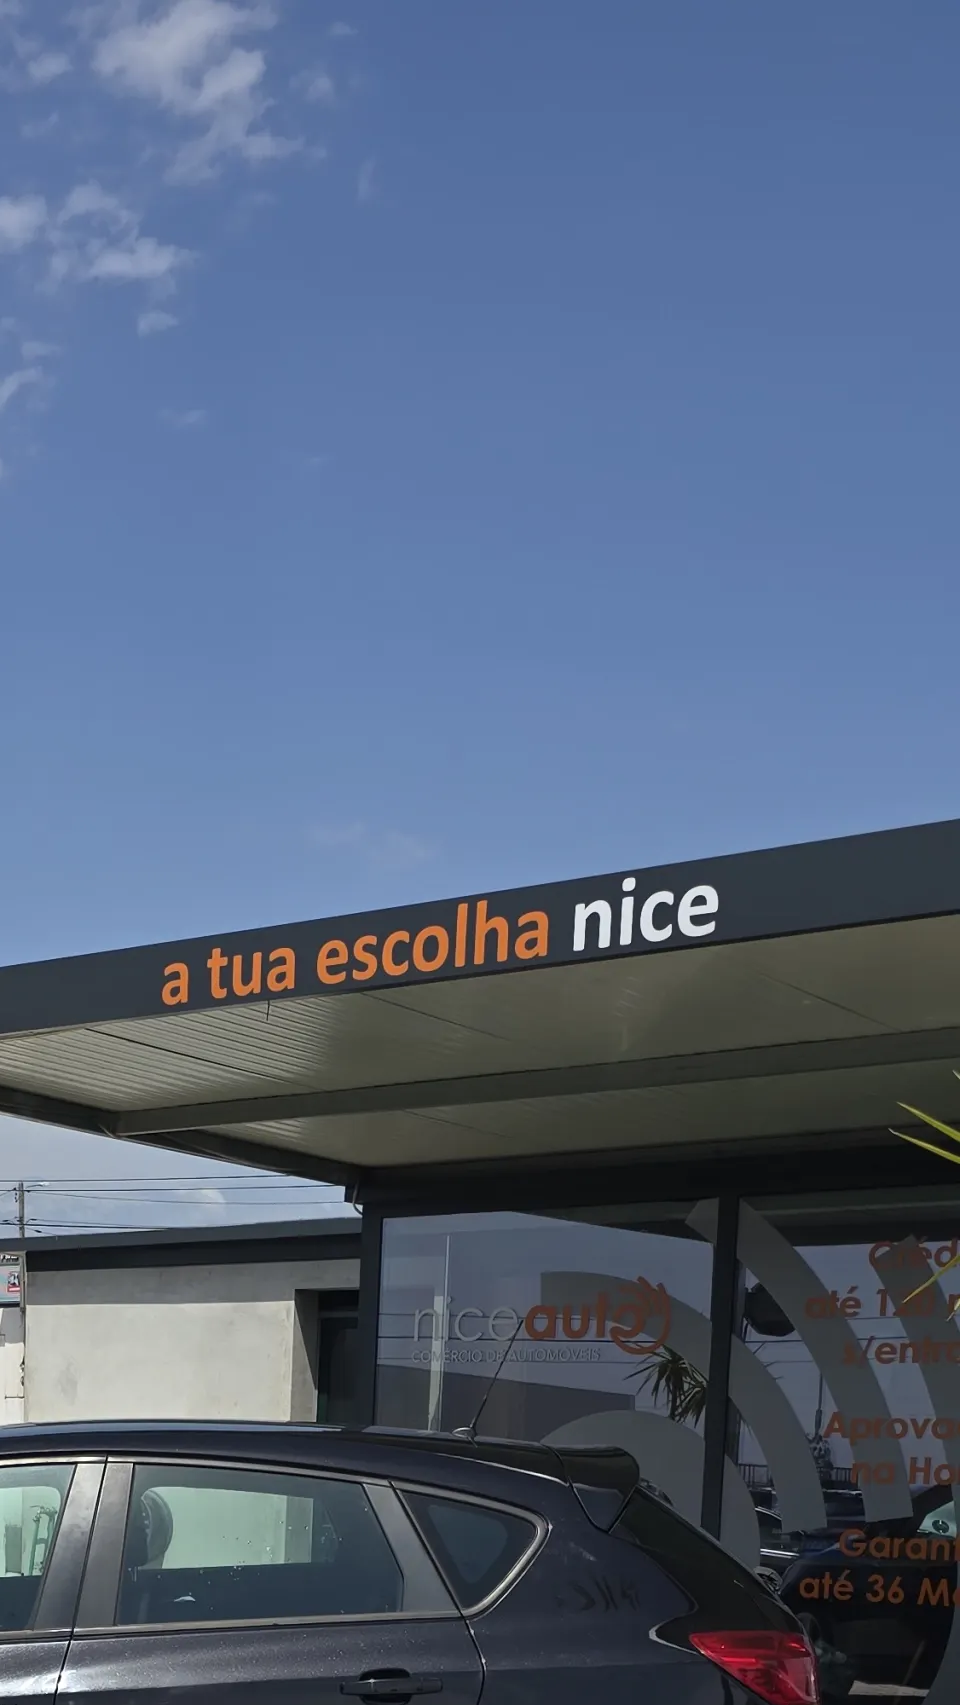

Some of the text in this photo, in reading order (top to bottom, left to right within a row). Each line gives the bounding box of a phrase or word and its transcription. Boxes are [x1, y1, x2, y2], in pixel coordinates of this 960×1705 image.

[161, 877, 719, 1006] a tua escolha nice
[869, 1236, 960, 1269] Créd
[804, 1285, 862, 1319] até
[851, 1461, 894, 1485] na
[799, 1569, 854, 1600] até
[866, 1574, 904, 1604] 36
